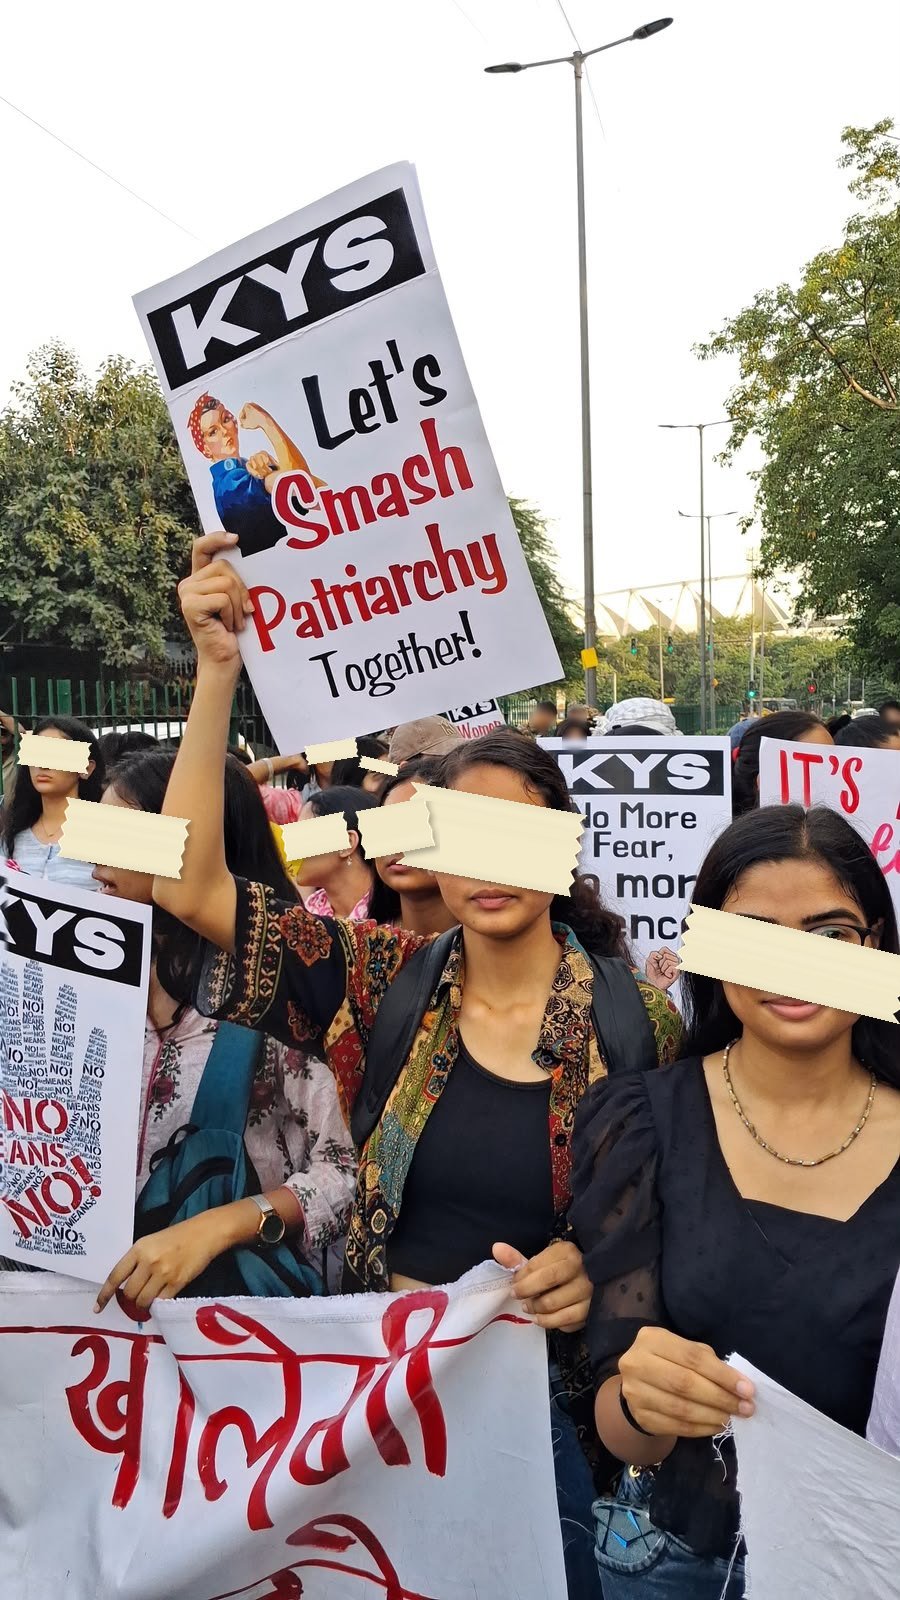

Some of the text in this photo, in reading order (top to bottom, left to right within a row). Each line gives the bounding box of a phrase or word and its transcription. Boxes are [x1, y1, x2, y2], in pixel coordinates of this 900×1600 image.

[171, 215, 394, 369] KYS
[302, 340, 447, 450] Let's
[274, 418, 473, 550] Smash
[249, 523, 508, 652] Patriarchy
[309, 611, 482, 698] Together!
[451, 701, 493, 720] KYS
[558, 753, 711, 790] KYS
[781, 750, 863, 813] IT'S
[620, 802, 697, 829] More
[593, 831, 673, 861] Fear,
[616, 873, 698, 898] mor
[23, 1000, 44, 1014] NO!
[54, 1021, 75, 1034] NO!
[30, 1067, 48, 1077] NO!
[50, 1063, 73, 1078] NO!
[82, 1063, 105, 1078] NO
[4, 1093, 69, 1135] NO
[66, 1102, 100, 1112] MEANS
[0, 1132, 66, 1168] ANS
[84, 1145, 102, 1156] NO
[86, 1161, 102, 1170] NO
[2, 1155, 102, 1238] NO!
[34, 1226, 51, 1237] NO
[52, 1225, 78, 1242] NO
[53, 1242, 84, 1250] MEANS
